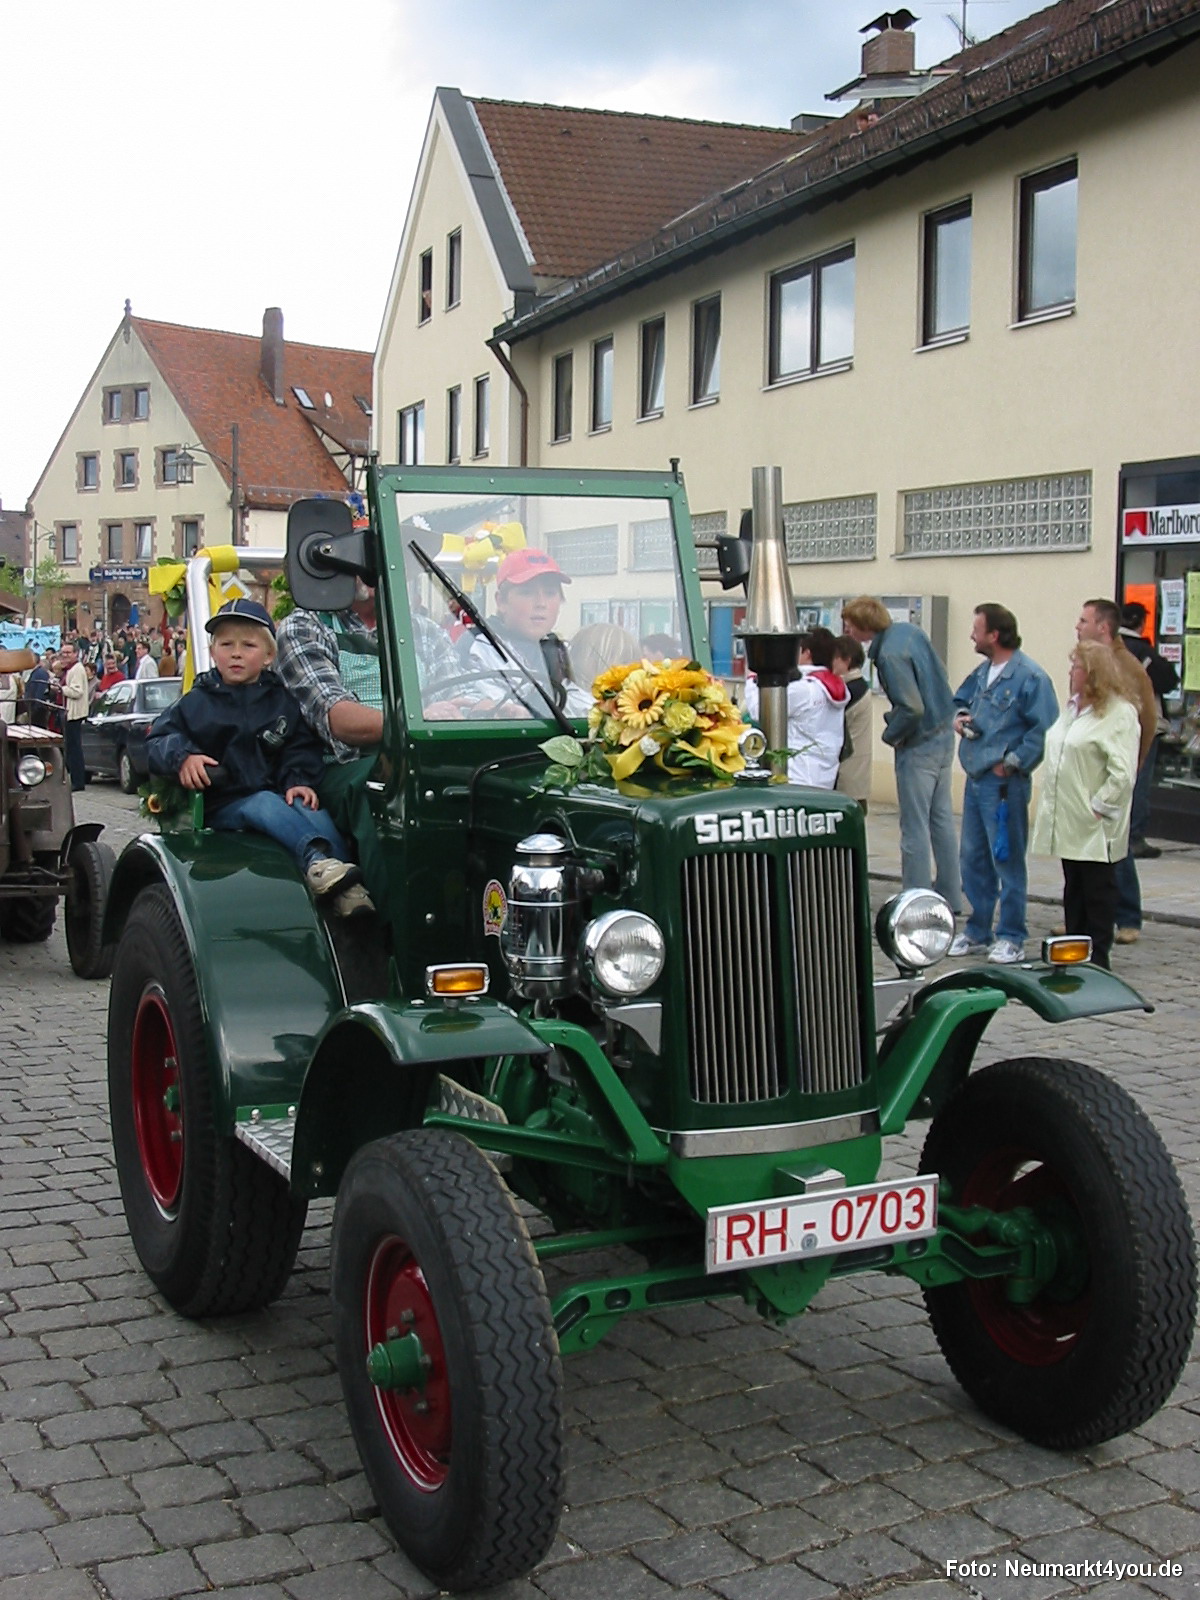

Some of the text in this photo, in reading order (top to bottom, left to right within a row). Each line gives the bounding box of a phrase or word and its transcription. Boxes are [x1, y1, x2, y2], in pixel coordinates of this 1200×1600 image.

[694, 807, 844, 845] Schlüter
[726, 1207, 788, 1261] RH
[831, 1187, 926, 1242] 0703
